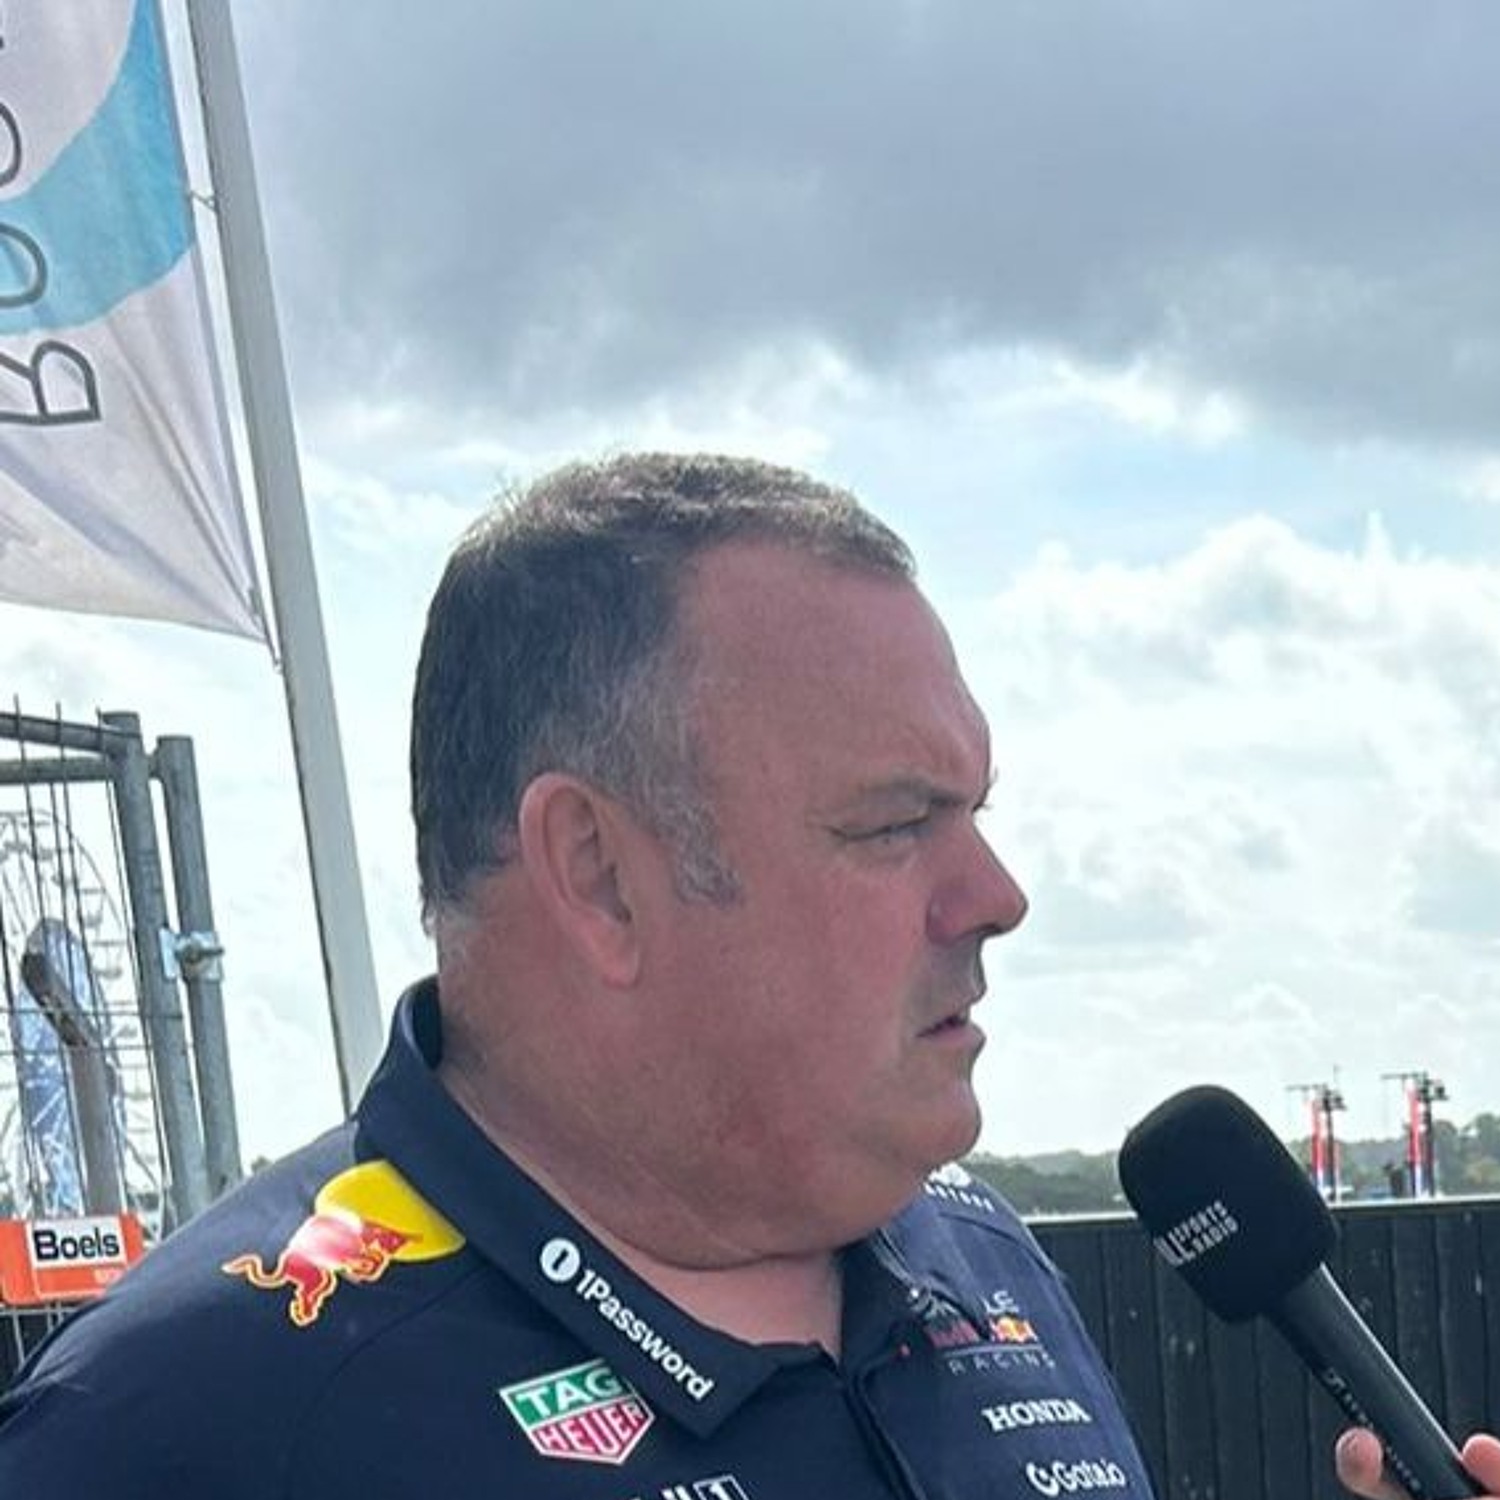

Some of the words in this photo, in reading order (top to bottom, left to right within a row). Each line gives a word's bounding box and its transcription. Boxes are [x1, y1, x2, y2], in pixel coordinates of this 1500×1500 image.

[34, 1227, 120, 1260] Boels
[575, 1269, 716, 1401] 1Password
[517, 1369, 624, 1417] TAG
[981, 1399, 1092, 1432] HONDA
[538, 1402, 643, 1456] HEUER
